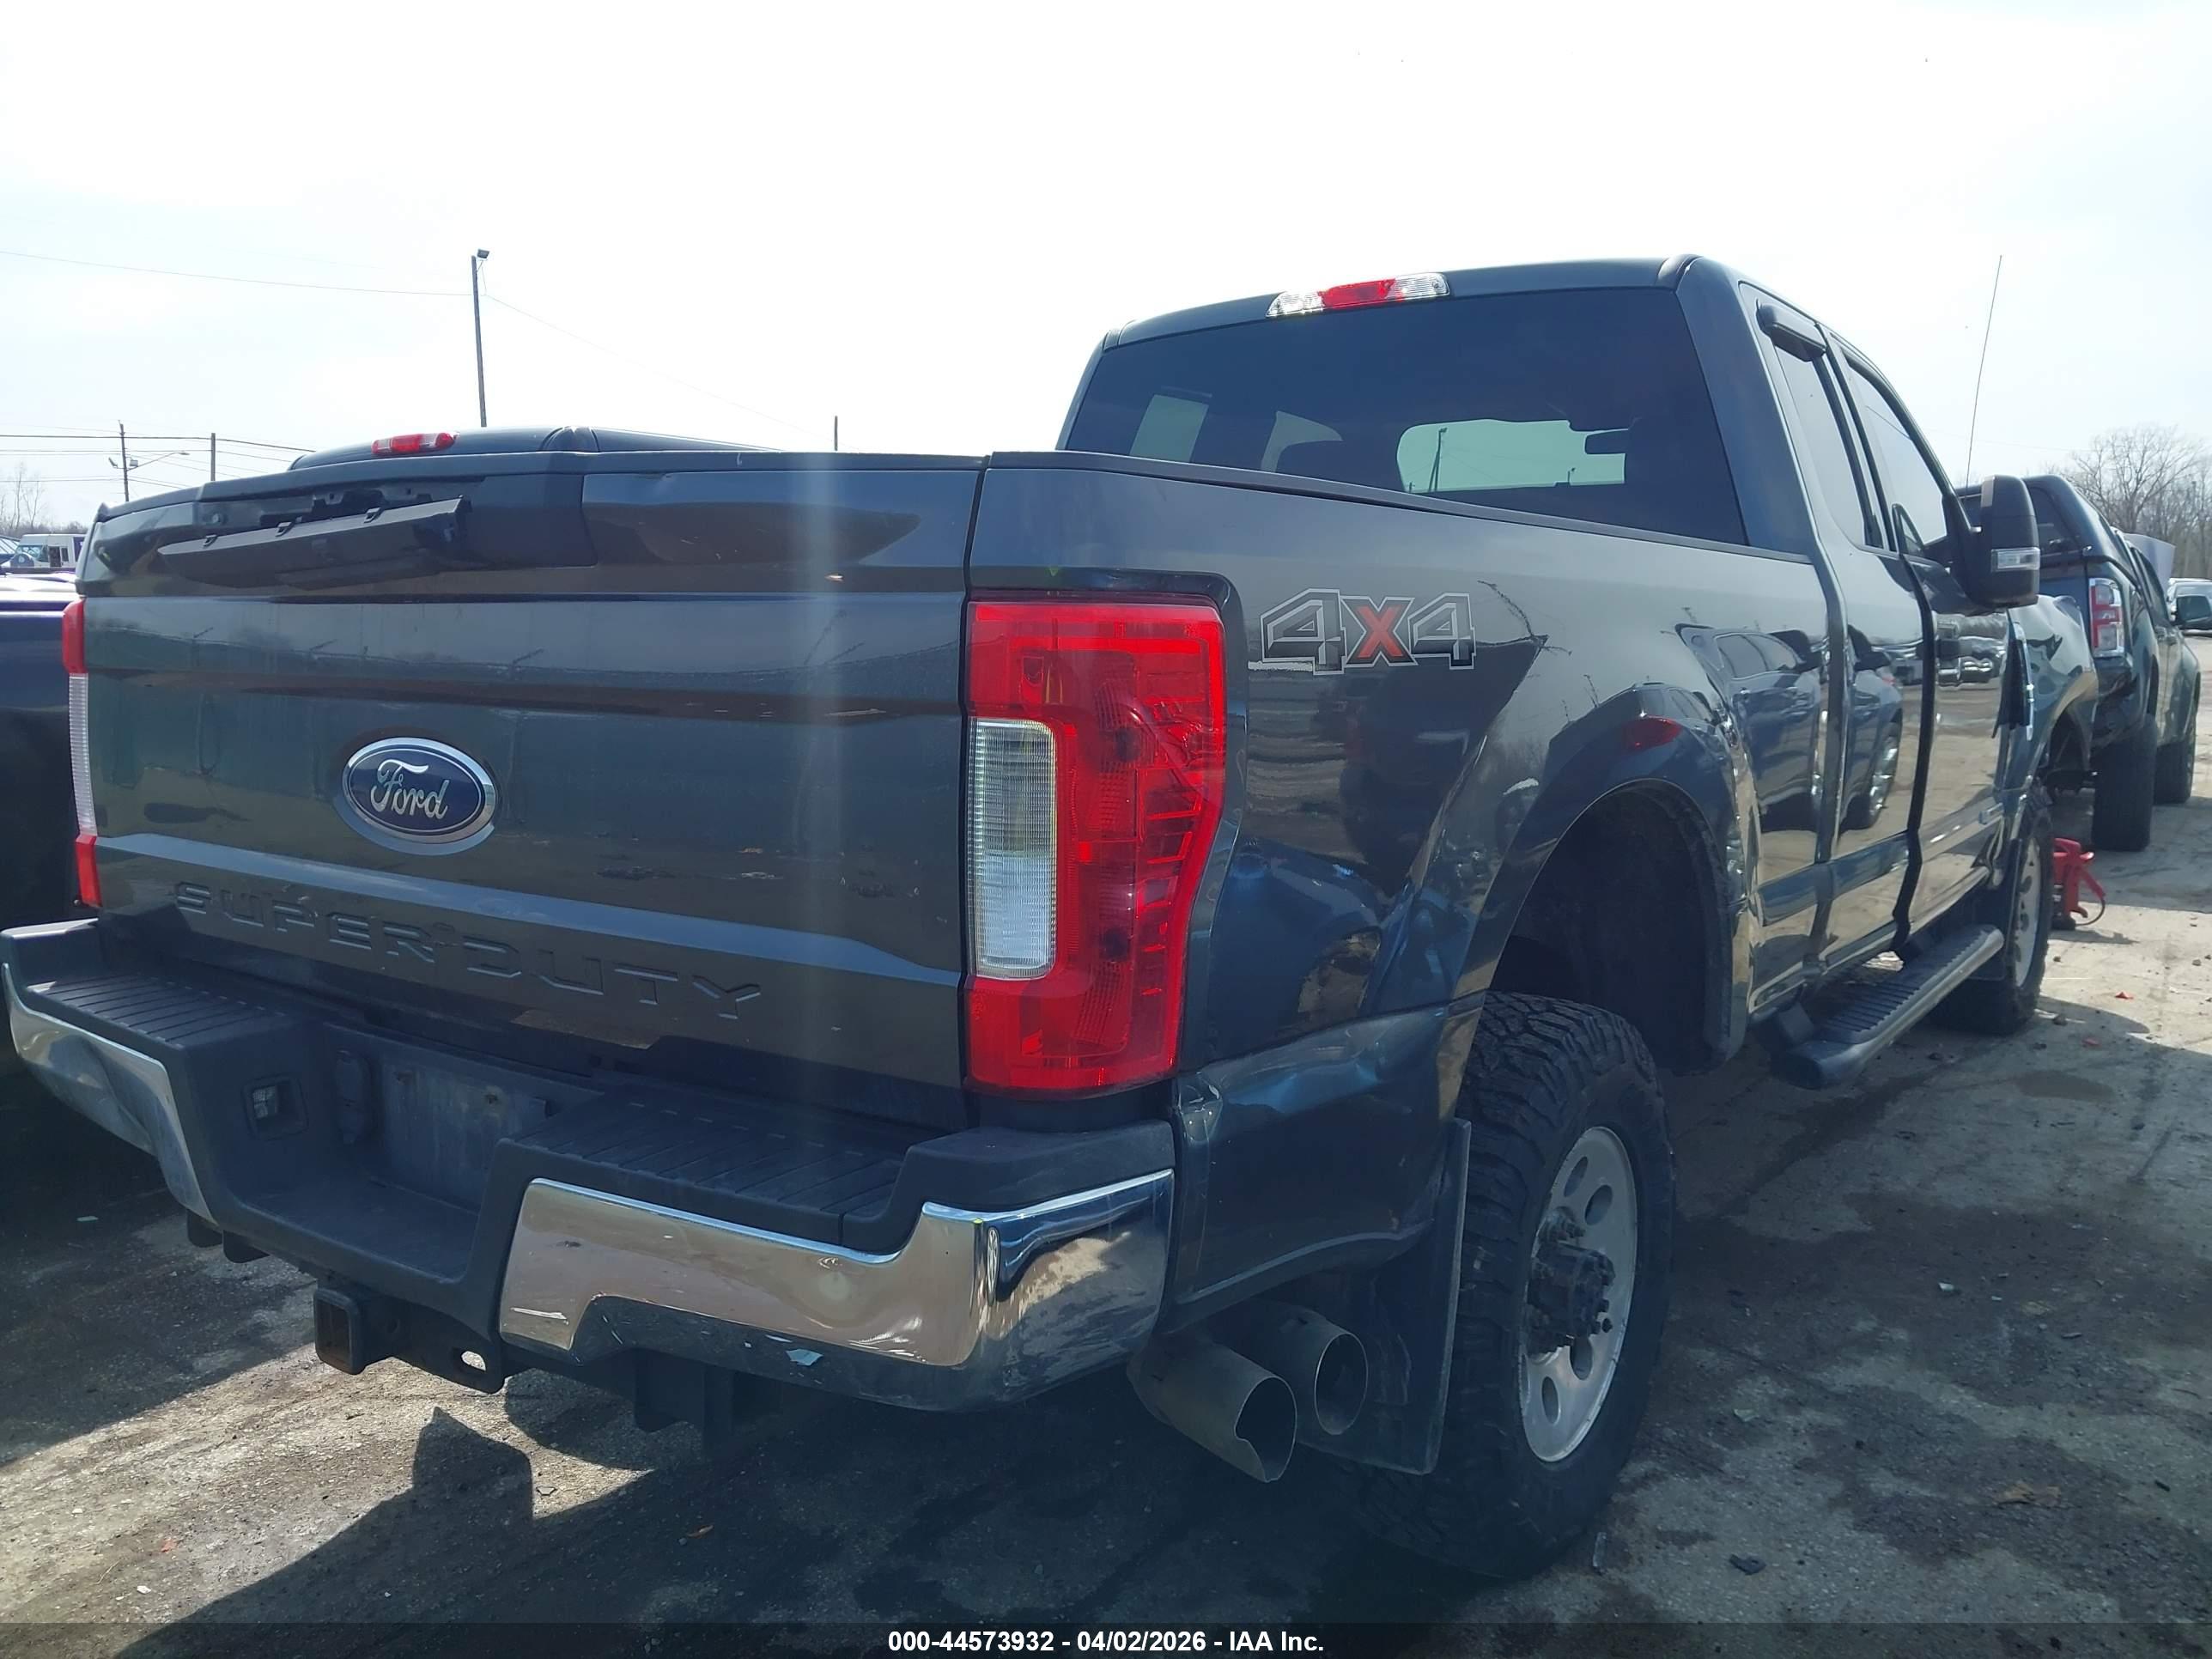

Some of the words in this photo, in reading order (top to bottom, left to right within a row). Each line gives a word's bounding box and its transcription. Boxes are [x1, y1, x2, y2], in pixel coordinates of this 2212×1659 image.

[369, 758, 451, 821] Ford
[176, 882, 434, 963] SUPER
[462, 934, 762, 1020] DUTY
